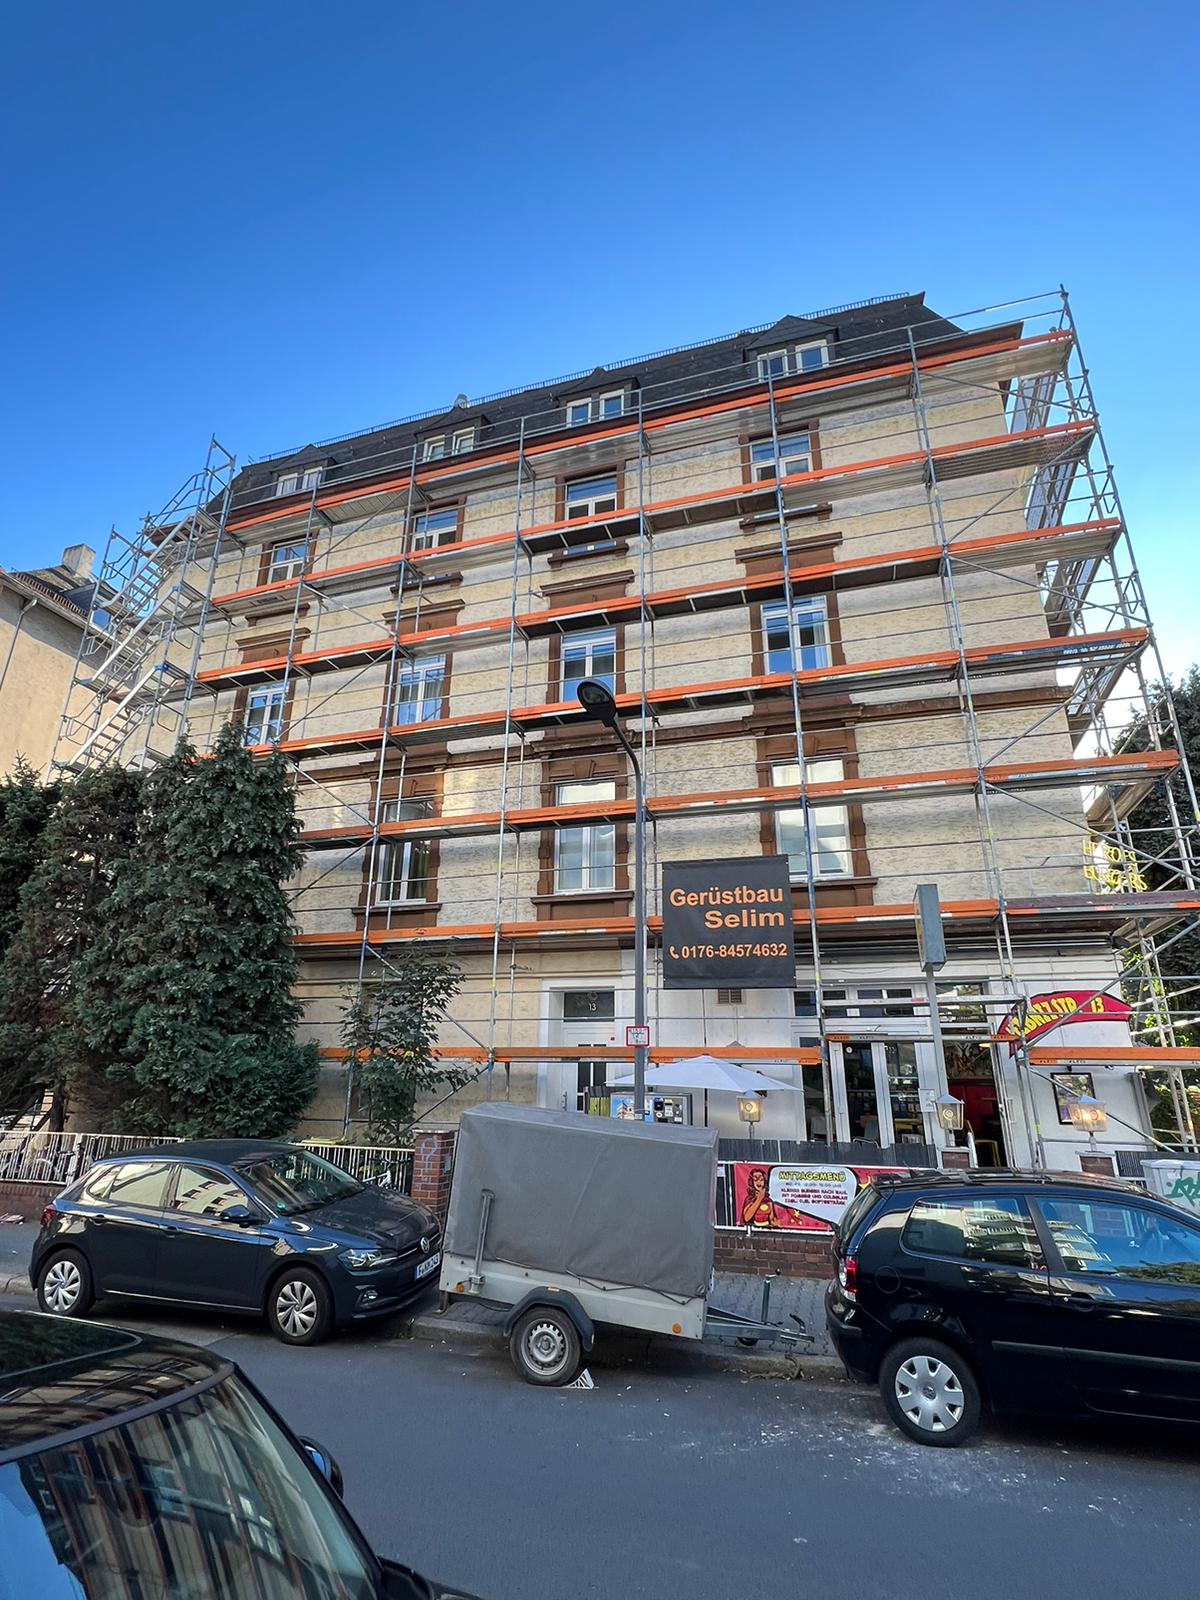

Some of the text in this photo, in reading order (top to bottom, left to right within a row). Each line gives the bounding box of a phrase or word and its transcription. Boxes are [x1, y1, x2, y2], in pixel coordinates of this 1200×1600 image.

[670, 885, 783, 907] Gerüstbau
[704, 909, 785, 929] Selim
[681, 943, 788, 959] 0176-84574632
[589, 1003, 597, 1012] 13
[1090, 997, 1105, 1013] 13
[779, 1171, 846, 1182] MITTAGSMENÜ
